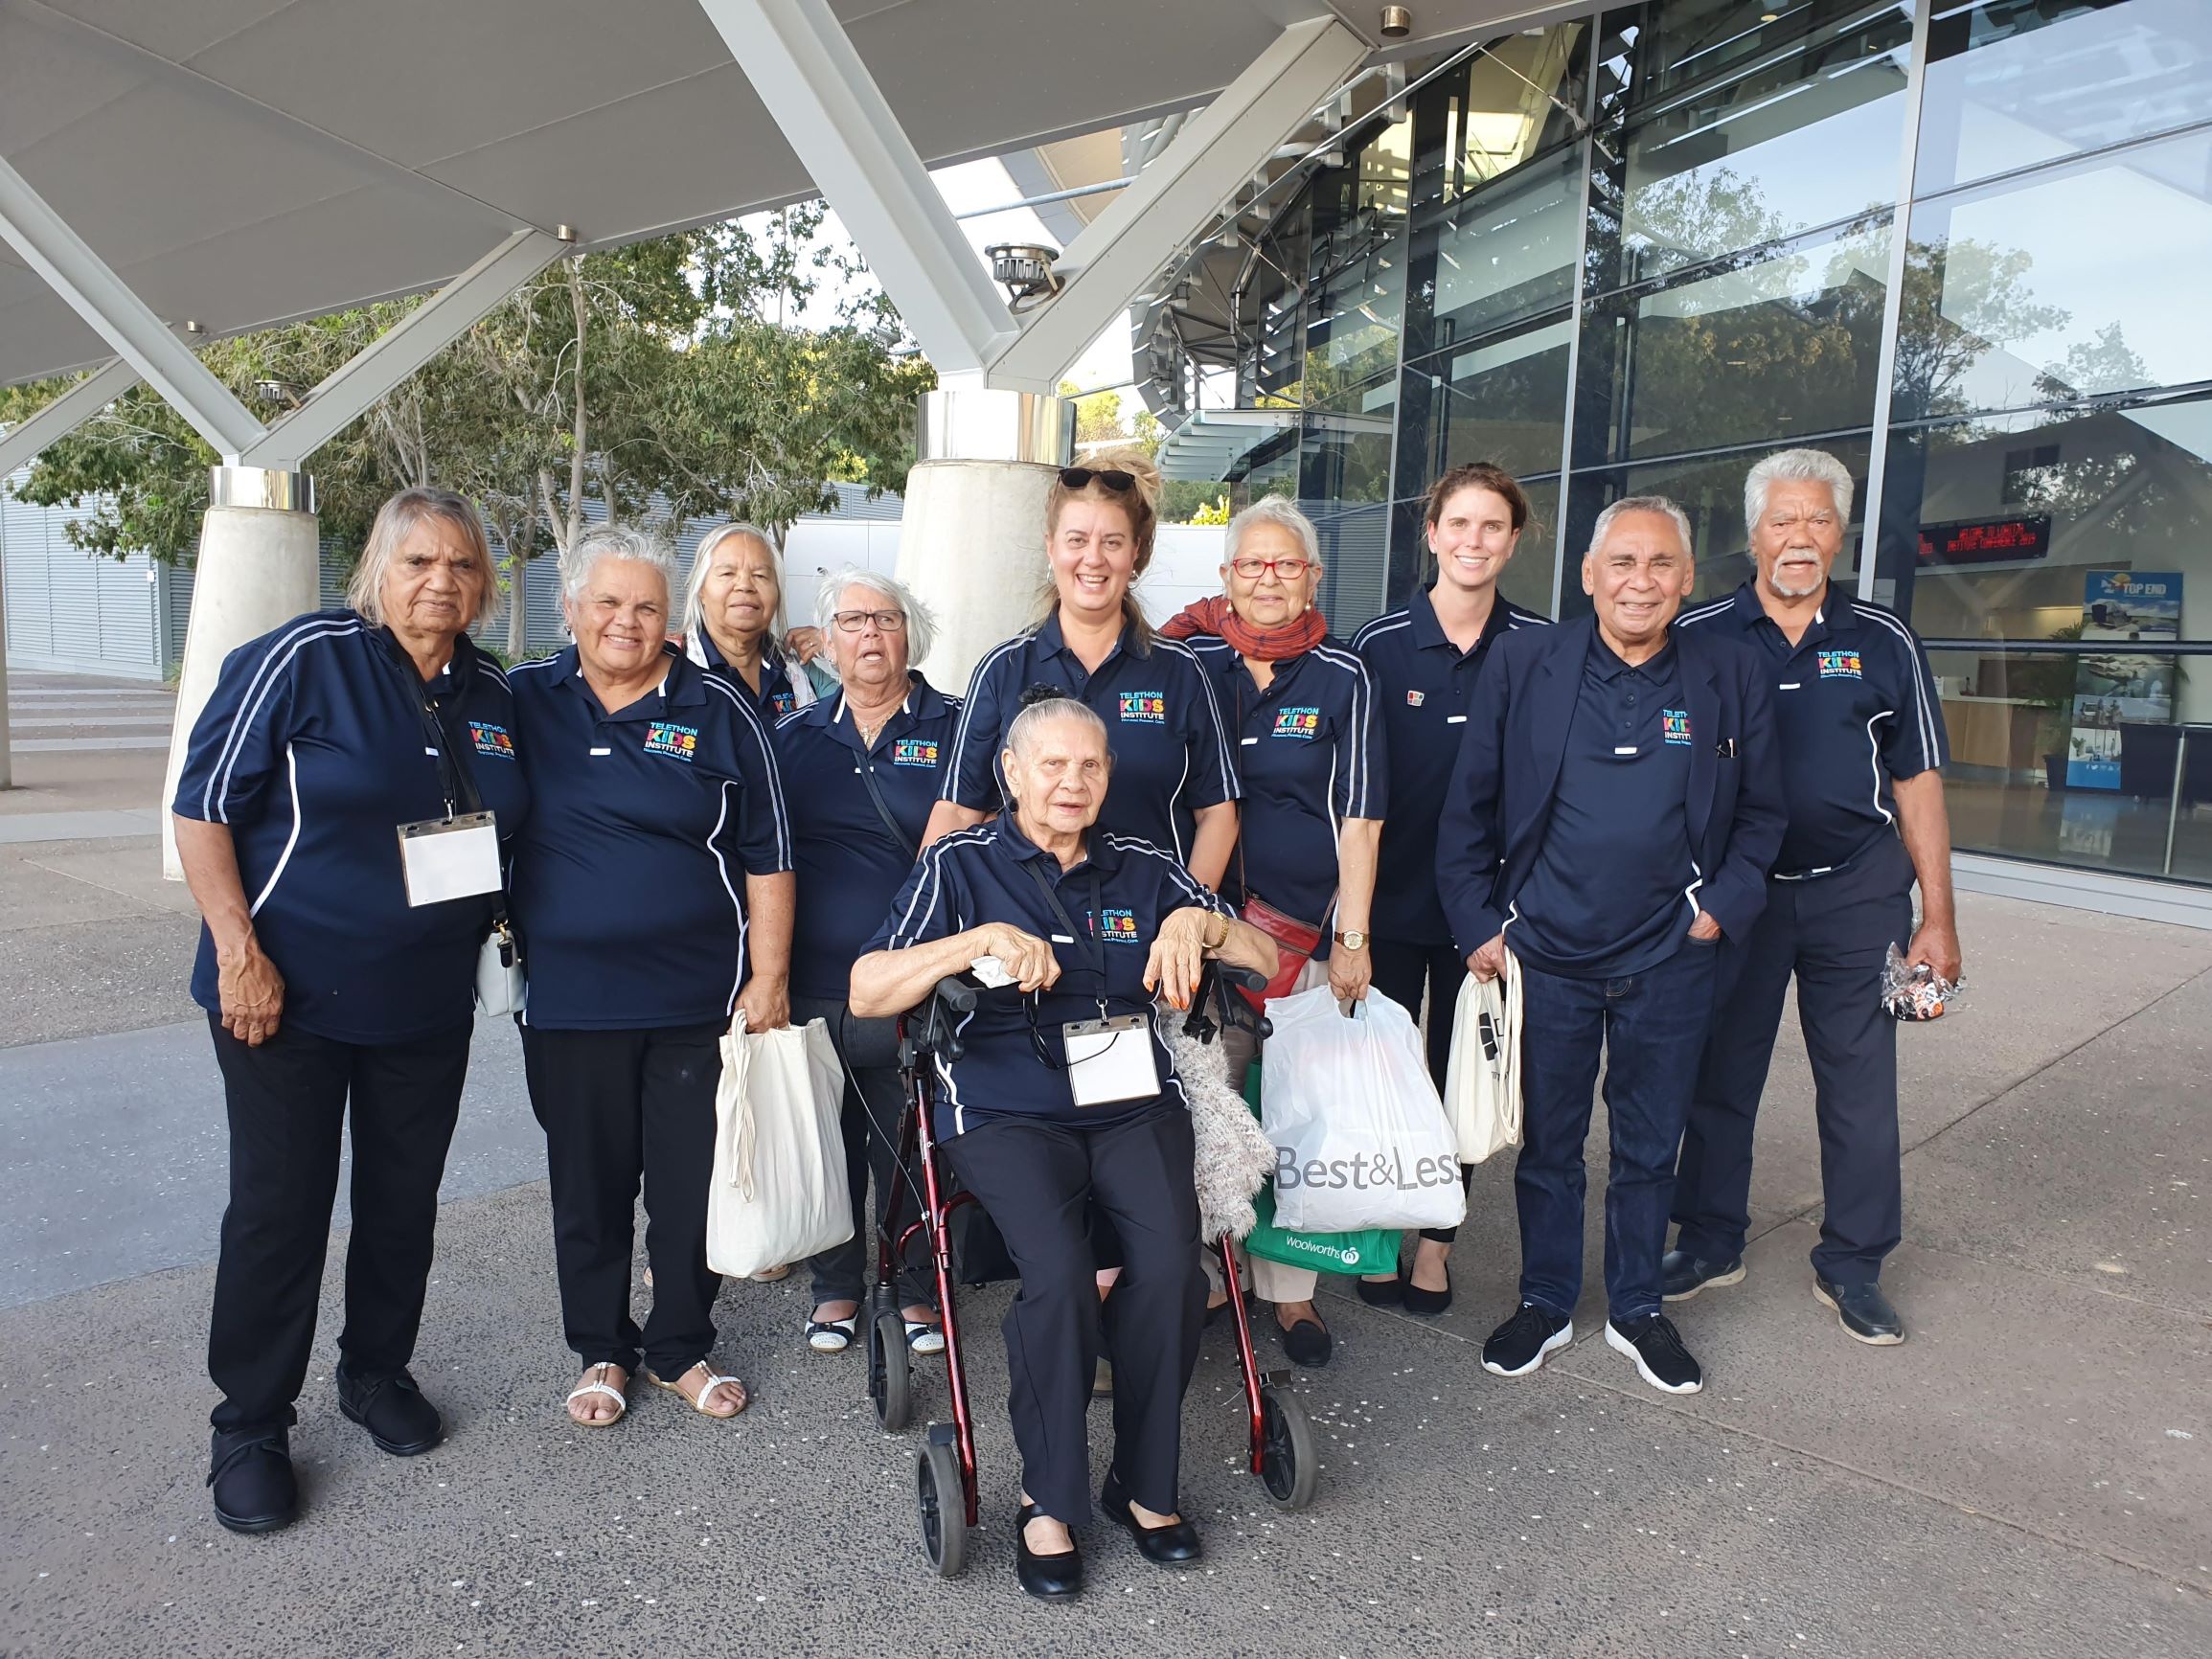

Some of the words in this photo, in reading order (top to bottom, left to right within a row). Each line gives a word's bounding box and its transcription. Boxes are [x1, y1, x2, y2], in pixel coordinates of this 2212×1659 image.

[2123, 582, 2144, 595] TOP
[2145, 583, 2167, 595] END
[1818, 657, 1861, 670] KIDS
[1820, 668, 1862, 676] INSTITUTE
[1119, 691, 1163, 699] TELETHON
[1119, 699, 1164, 714] KIDS
[1279, 707, 1320, 716] TELETHON
[1120, 712, 1165, 720] INSTITUTE
[1274, 715, 1318, 728] KIDS
[468, 721, 507, 735] TELETHON
[650, 721, 698, 737] TELETHON
[1662, 716, 1692, 733] KID
[1273, 727, 1315, 736] INSTITUTE
[470, 728, 513, 749] KIDS
[647, 729, 696, 750] KIDS
[896, 739, 938, 747] TELETHON
[474, 742, 515, 757] INSTITUTE
[645, 740, 695, 758] INSTITUTE
[895, 745, 937, 759] KIDS
[894, 756, 937, 764] INSTITUTE
[1287, 1236, 1341, 1260] Woolworths
